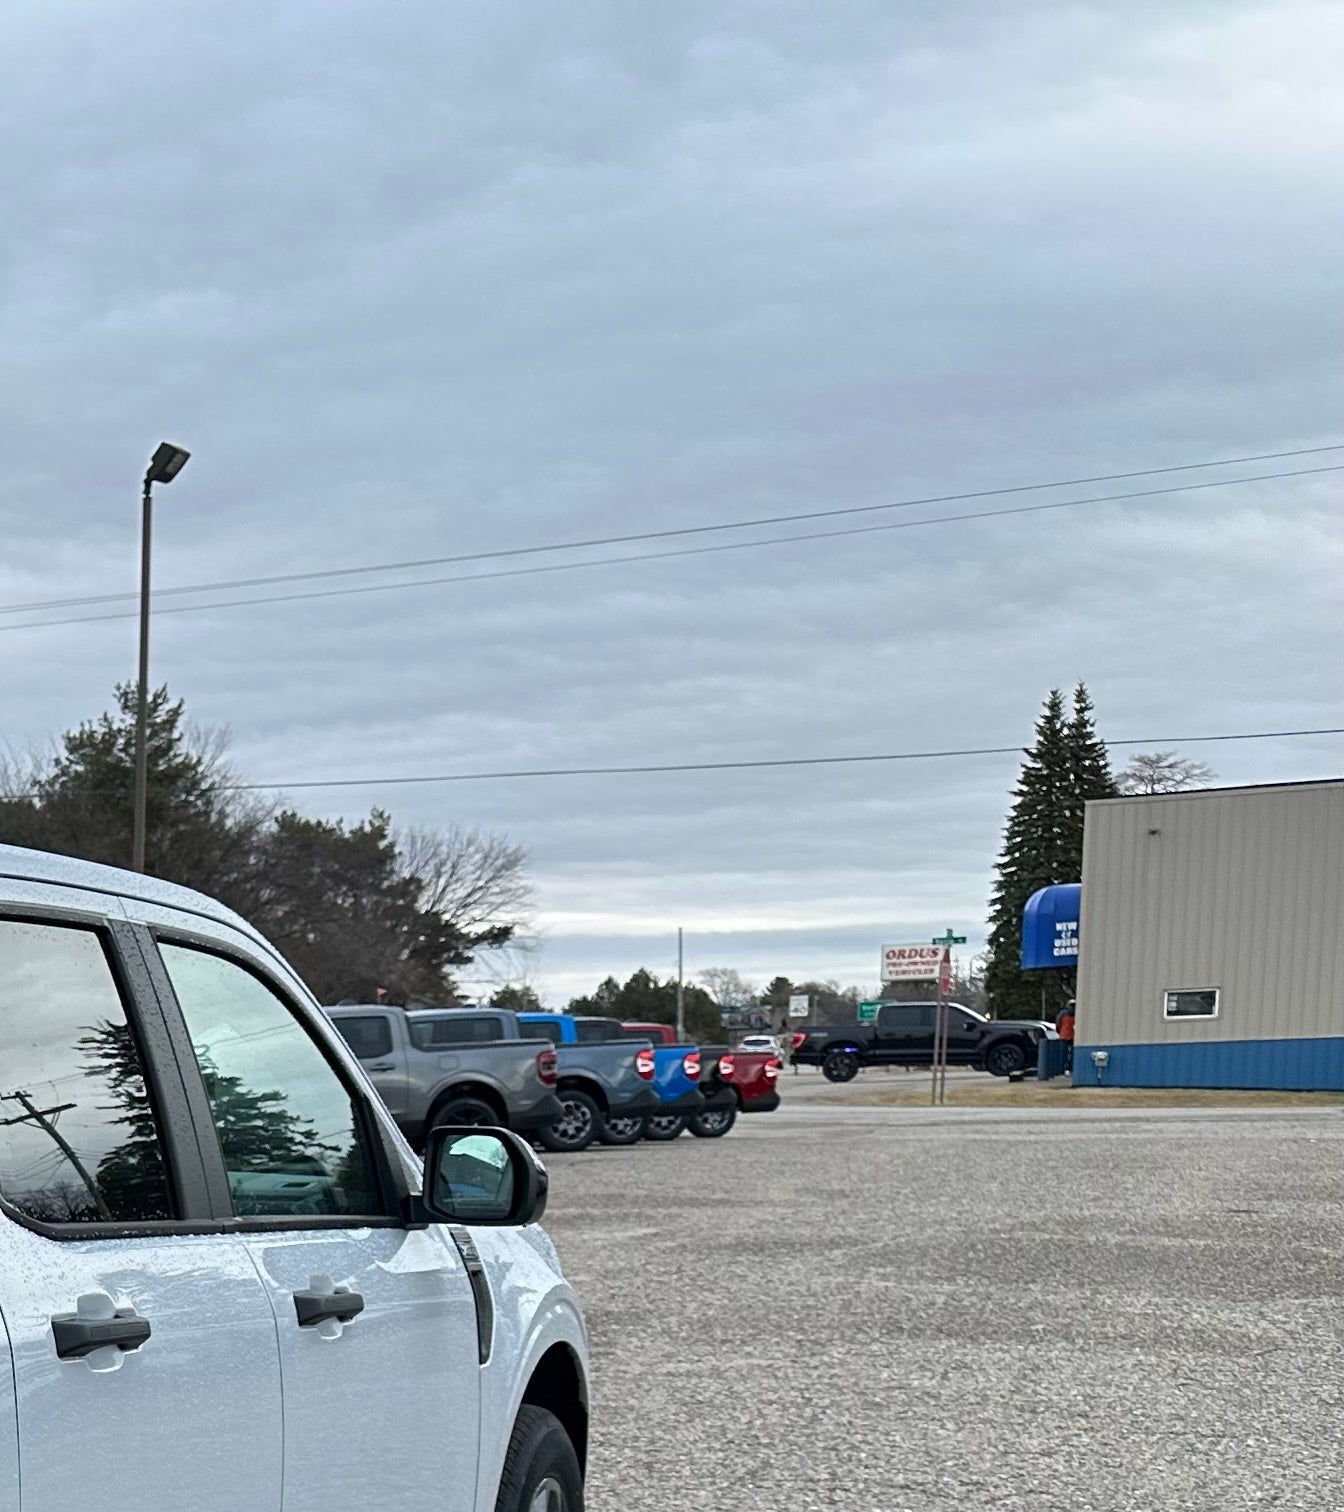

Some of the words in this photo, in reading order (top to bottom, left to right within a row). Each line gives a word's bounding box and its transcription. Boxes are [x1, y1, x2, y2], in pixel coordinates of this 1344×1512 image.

[1055, 921, 1078, 931] NEW
[1053, 938, 1079, 947] USED
[885, 947, 940, 960] ORDUS
[1053, 947, 1079, 956] CARS
